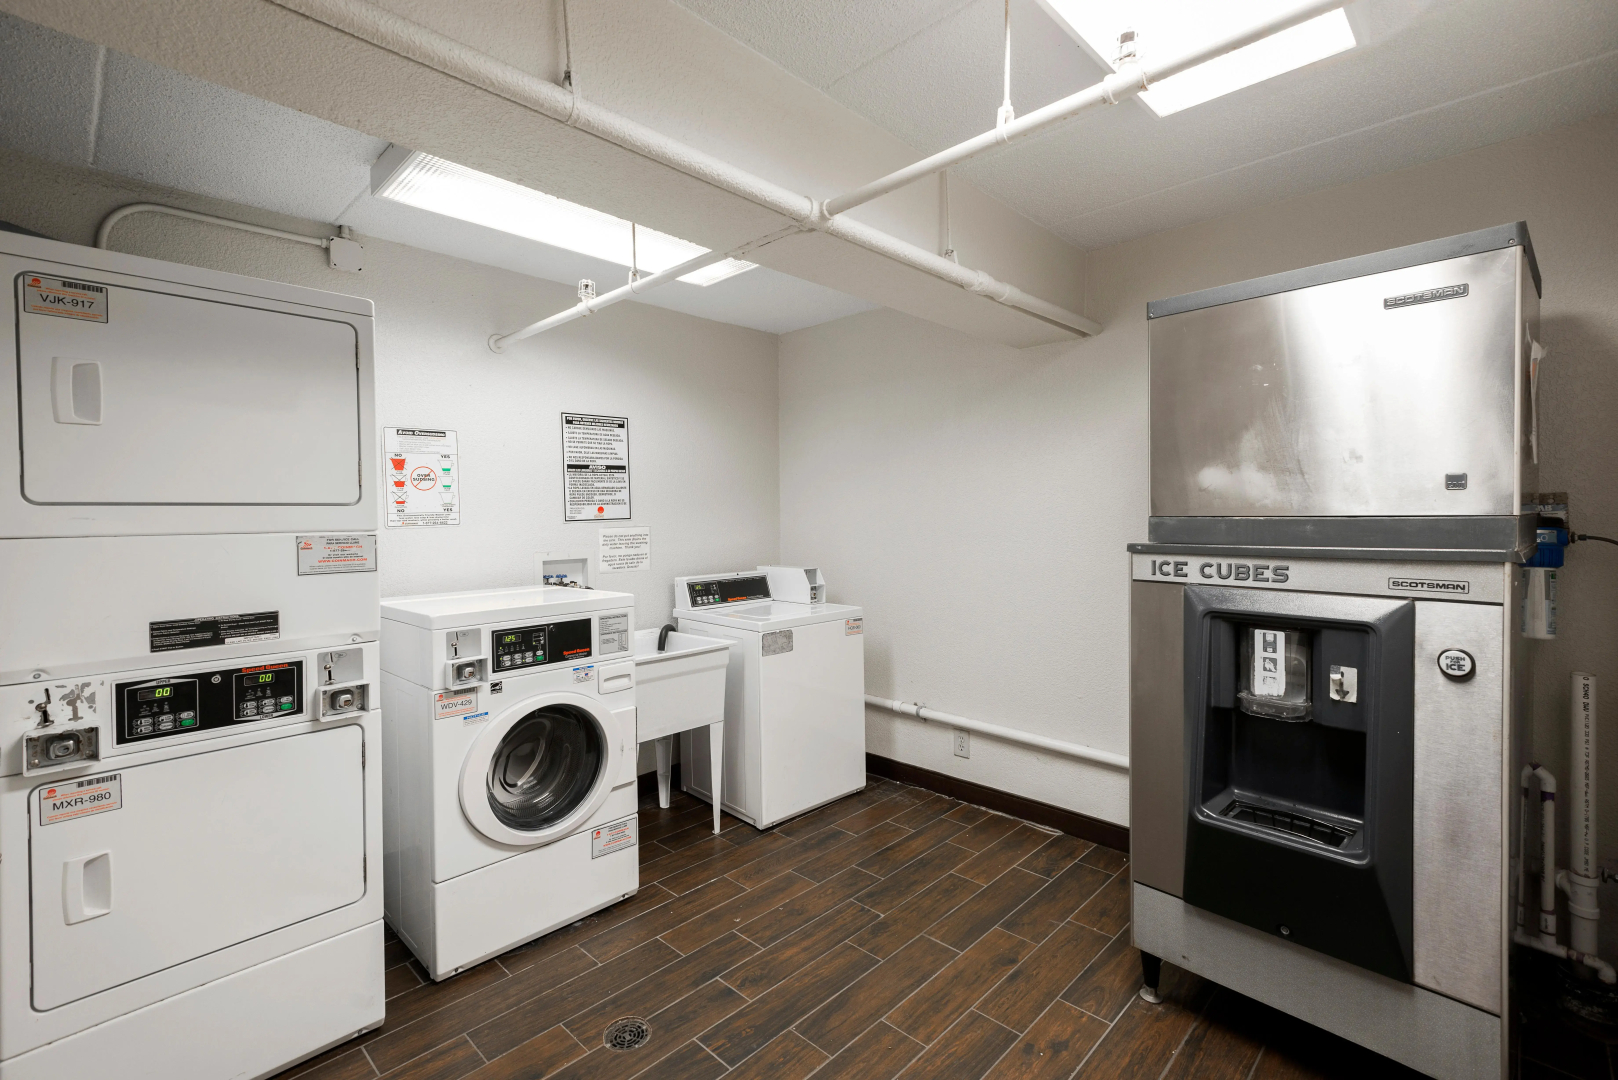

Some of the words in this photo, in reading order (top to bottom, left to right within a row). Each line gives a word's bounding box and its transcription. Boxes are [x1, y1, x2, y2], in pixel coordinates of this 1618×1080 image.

[1387, 286, 1464, 305] SCOTSMAN
[40, 294, 94, 309] VJK-917
[1151, 560, 1188, 577] ICE
[1199, 562, 1290, 583] CUBES
[1392, 581, 1465, 590] SCOTSMAN
[1446, 663, 1465, 671] ICE
[259, 674, 272, 682] 00
[155, 688, 171, 697] 00
[441, 699, 472, 710] WDV-429
[53, 792, 111, 810] MXR-980
